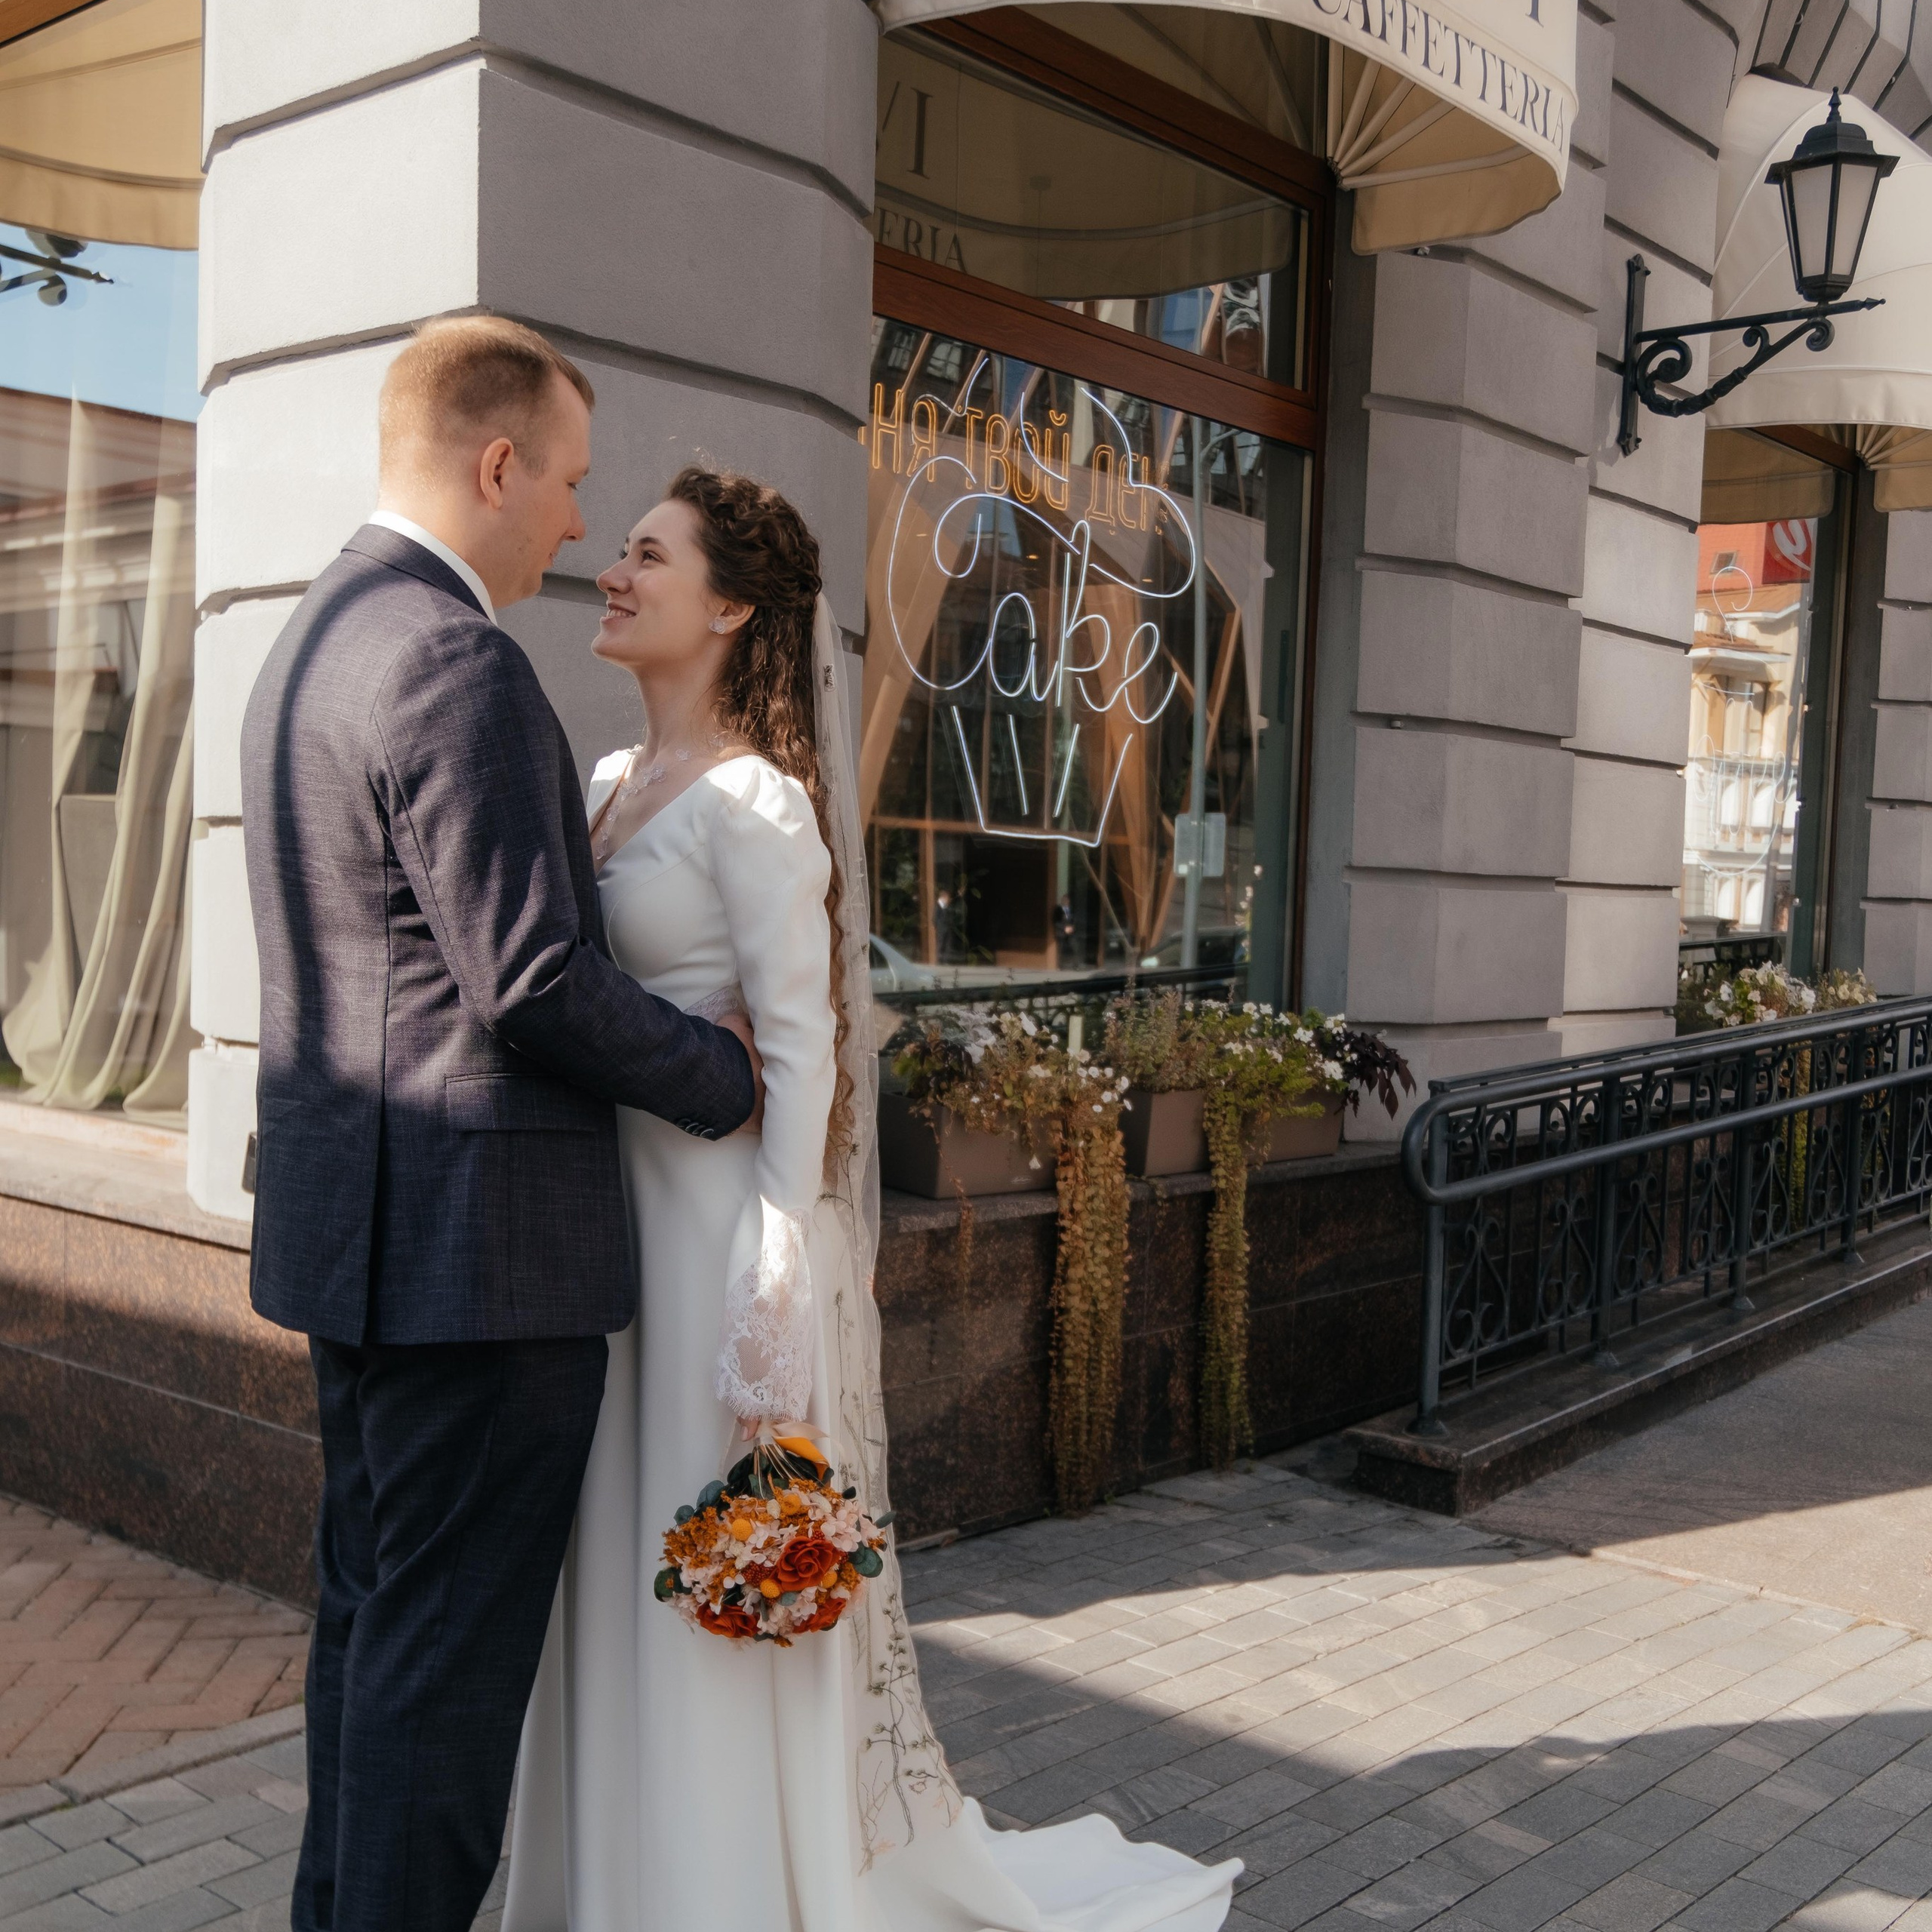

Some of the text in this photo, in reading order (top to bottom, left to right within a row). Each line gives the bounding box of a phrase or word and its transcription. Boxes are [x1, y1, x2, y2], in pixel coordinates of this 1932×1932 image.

[1312, 0, 1564, 156] AFFETTERIA
[857, 382, 937, 483] НЯ
[958, 405, 1071, 512] ТВОЙ
[888, 455, 1178, 724] Cake
